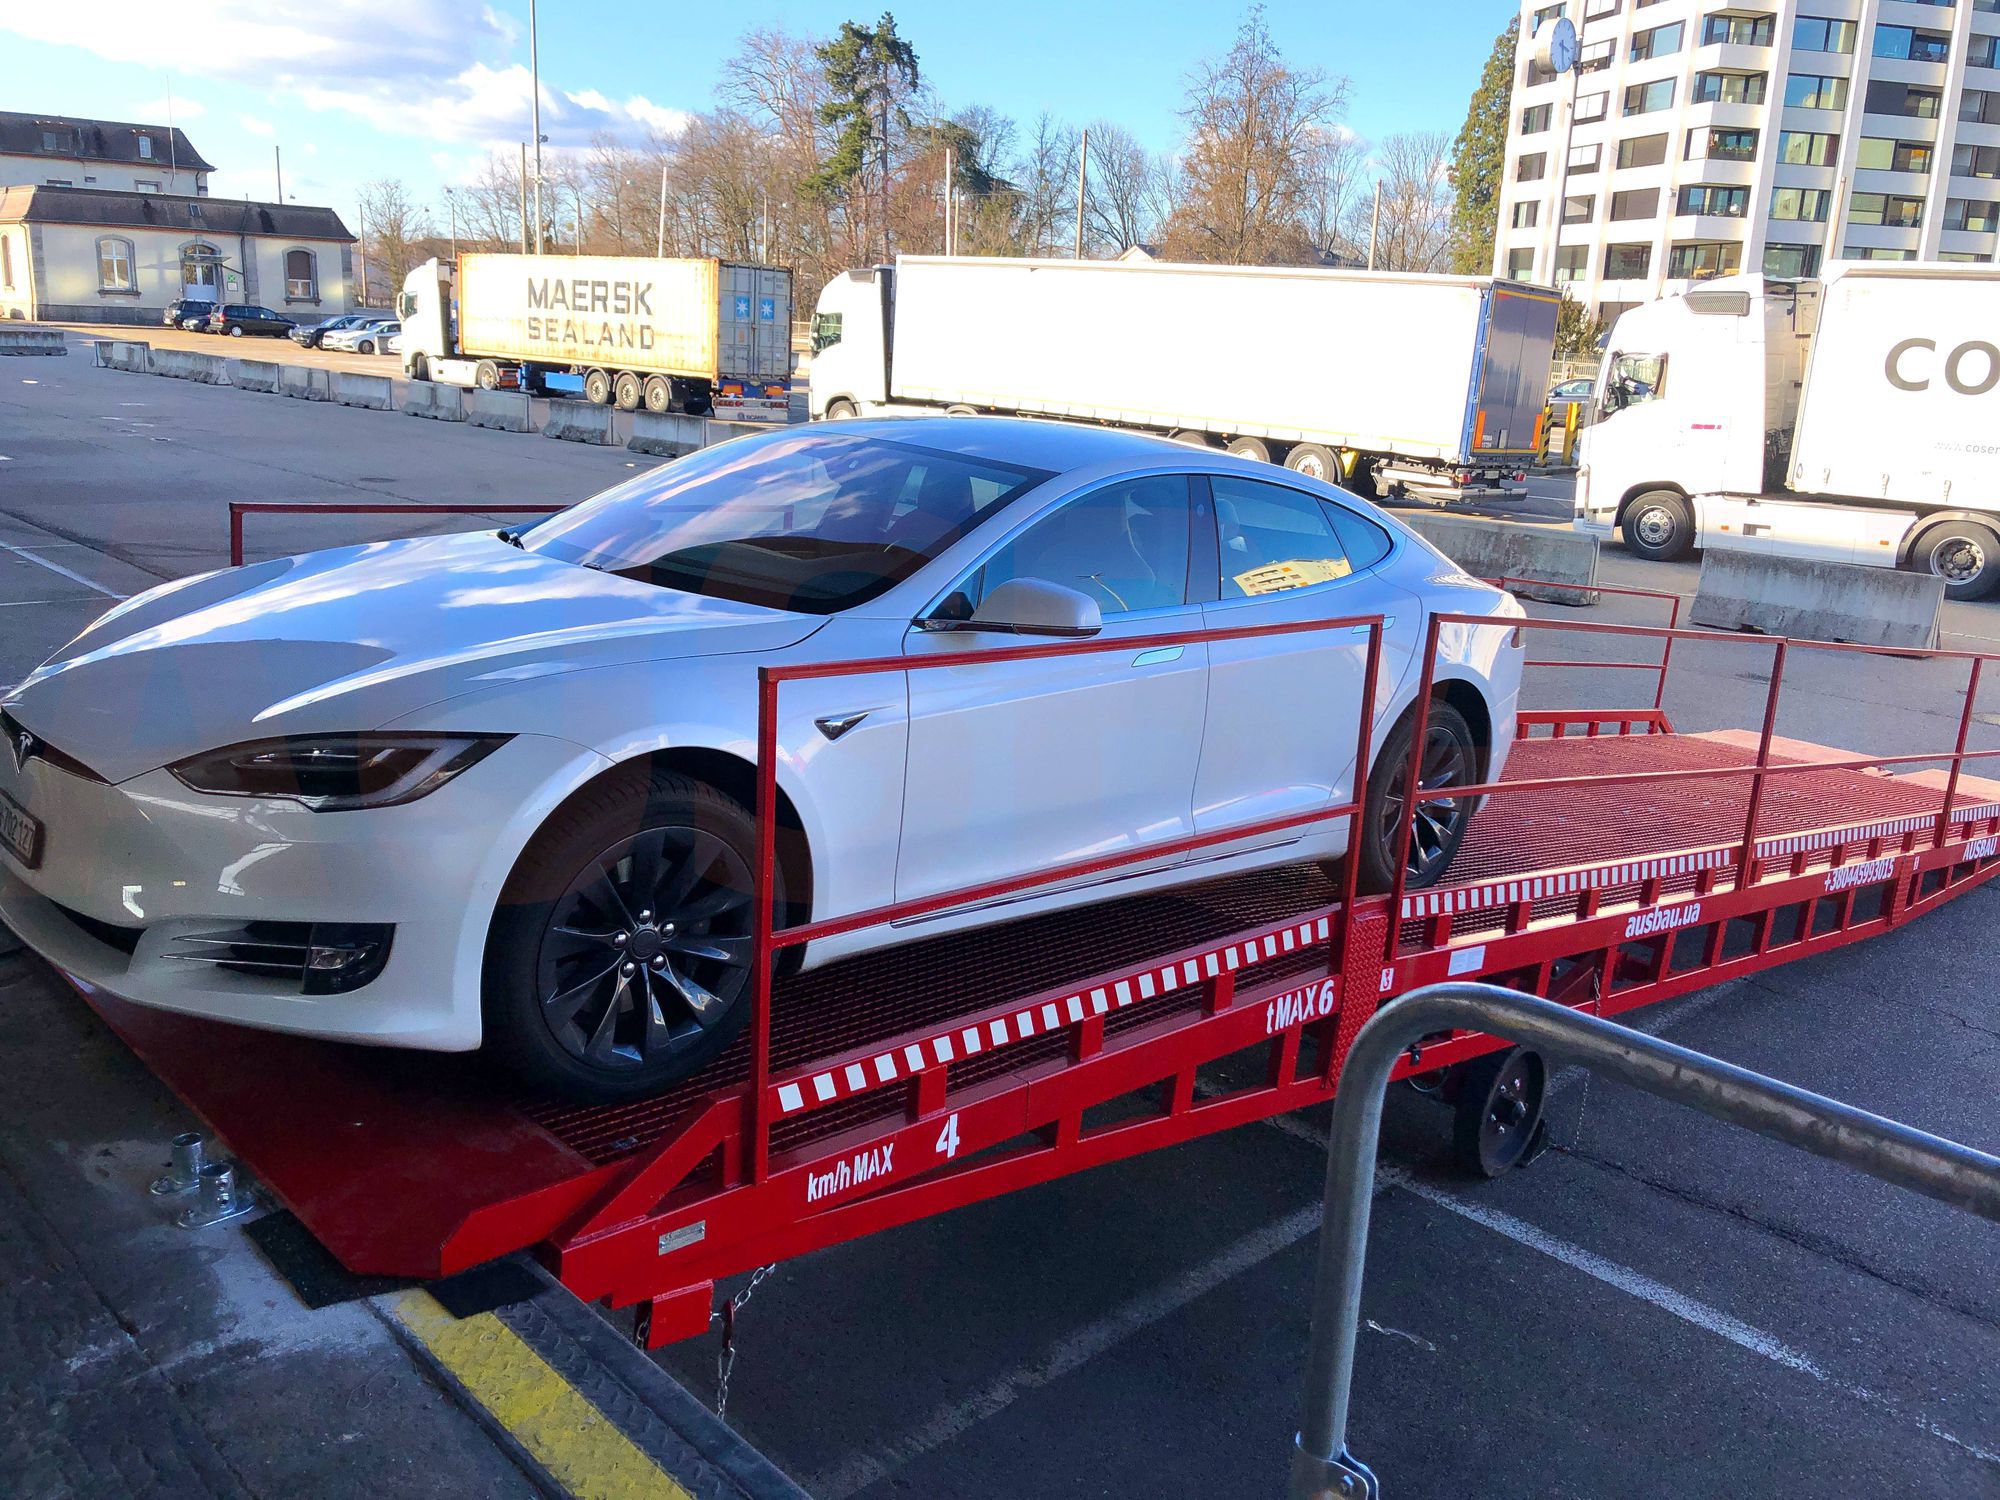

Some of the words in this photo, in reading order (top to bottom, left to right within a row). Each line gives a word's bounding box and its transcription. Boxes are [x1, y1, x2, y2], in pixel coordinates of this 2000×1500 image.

[528, 278, 653, 315] MAERSK
[528, 317, 655, 350] SEALAND
[1885, 337, 2000, 395] CO
[1962, 836, 1998, 861] AUSBAU
[1625, 902, 1700, 938] ausbau.ua
[807, 1160, 850, 1203] km/h
[853, 1142, 894, 1185] MAX
[935, 1113, 961, 1159] 4
